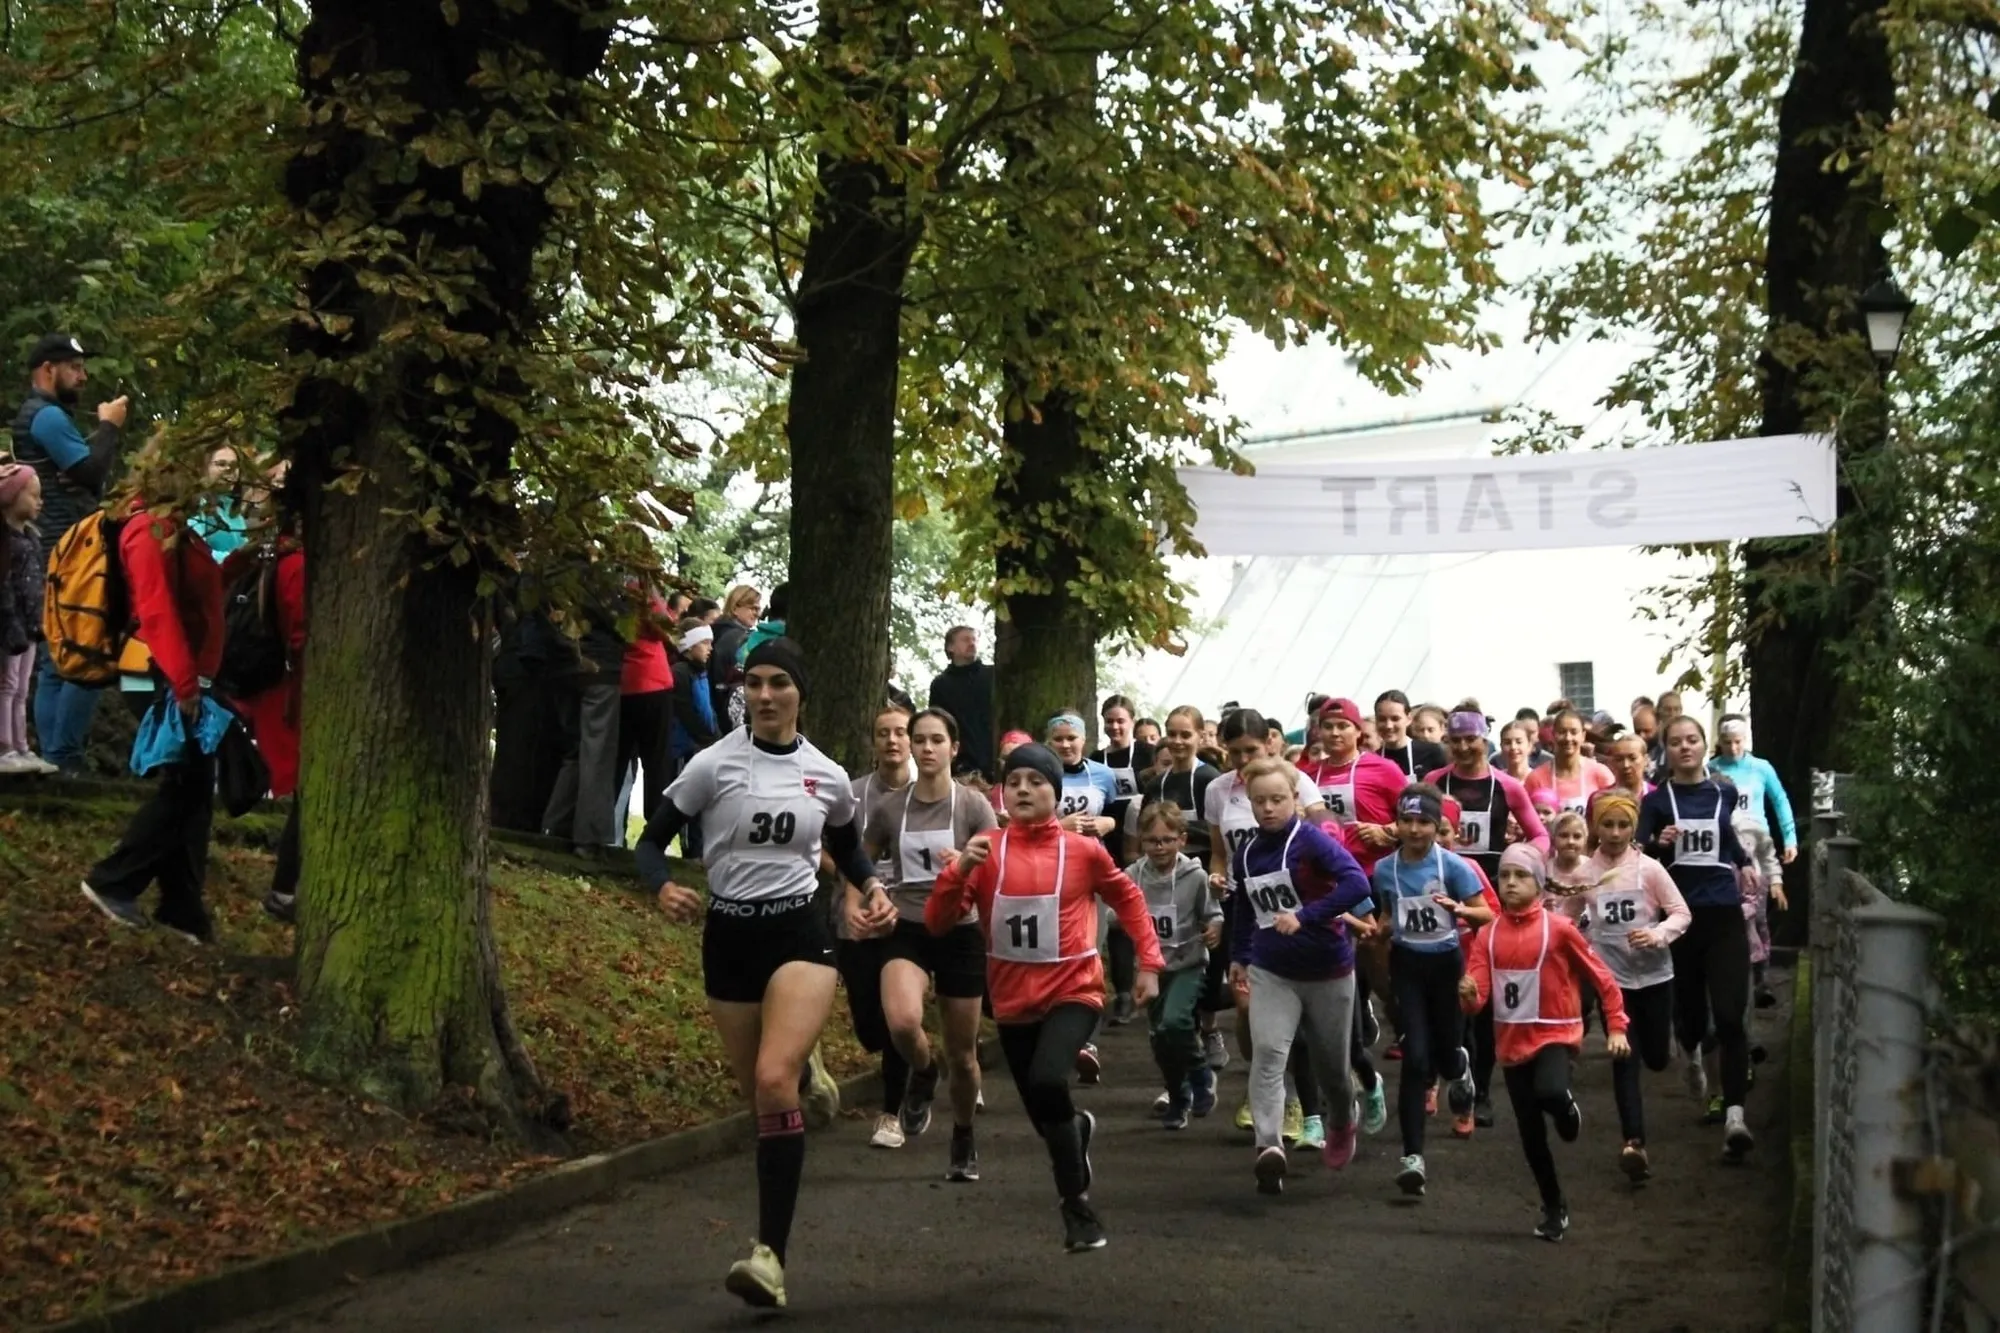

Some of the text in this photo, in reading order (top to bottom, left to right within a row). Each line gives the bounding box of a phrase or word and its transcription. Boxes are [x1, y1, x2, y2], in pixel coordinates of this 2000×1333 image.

[1063, 795, 1089, 816] 32
[749, 811, 796, 845] 39
[1682, 829, 1713, 852] 116
[918, 847, 931, 871] 1
[713, 900, 756, 917] PRO
[761, 896, 806, 916] NIKE
[1251, 884, 1297, 913] 103
[1404, 907, 1438, 932] 48
[1604, 900, 1635, 924] 36
[1006, 914, 1038, 948] 11
[1153, 915, 1173, 939] 9
[1505, 982, 1519, 1010] 8
